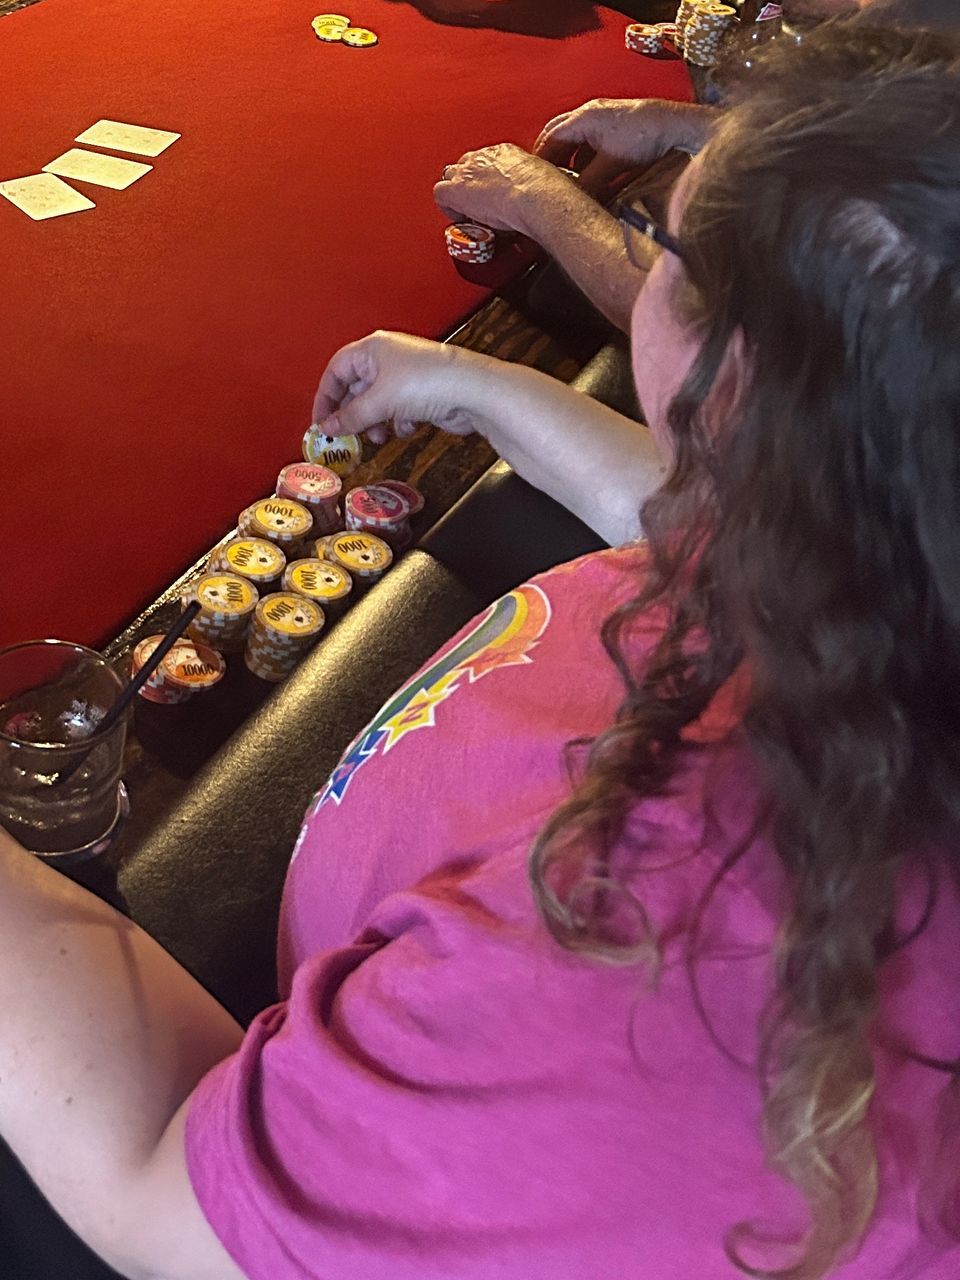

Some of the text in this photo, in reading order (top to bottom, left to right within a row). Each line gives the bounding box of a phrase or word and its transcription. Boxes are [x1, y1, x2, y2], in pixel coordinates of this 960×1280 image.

[323, 448, 352, 466] 1000
[295, 468, 323, 482] 5000
[264, 503, 295, 518] 1000
[337, 538, 368, 554] 1000
[232, 547, 254, 568] 1000
[301, 570, 318, 591] 1000
[226, 581, 243, 603] 1000
[266, 601, 295, 622] 1000
[182, 662, 215, 678] 10000
